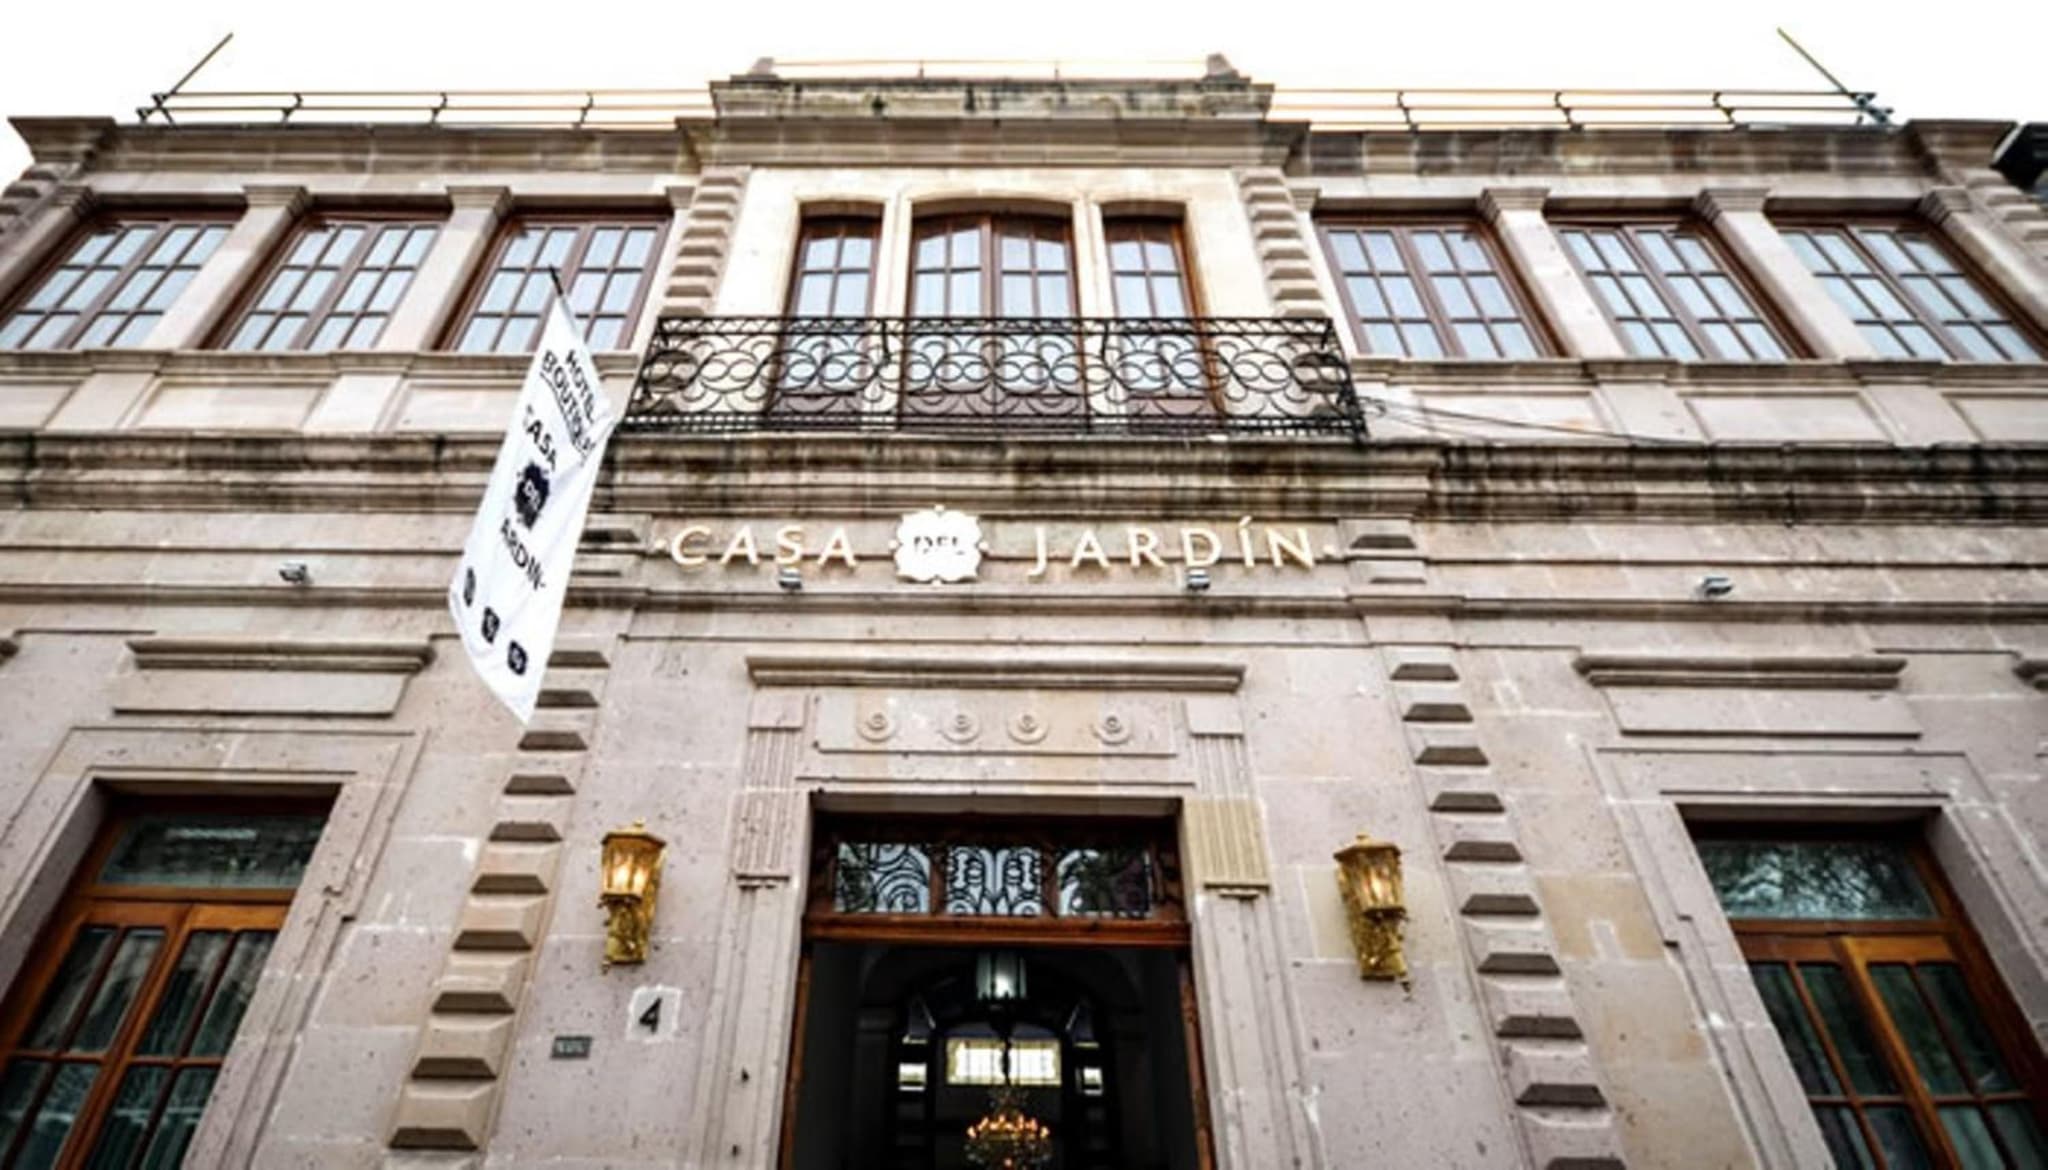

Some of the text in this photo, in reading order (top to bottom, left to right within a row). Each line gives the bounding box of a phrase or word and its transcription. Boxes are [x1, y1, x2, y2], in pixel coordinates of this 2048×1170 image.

[541, 350, 597, 451] BOUTIQU
[566, 349, 595, 424] HOTEL
[670, 524, 858, 568] CASA
[1026, 515, 1315, 578] JARDÍN
[638, 996, 663, 1035] 4
